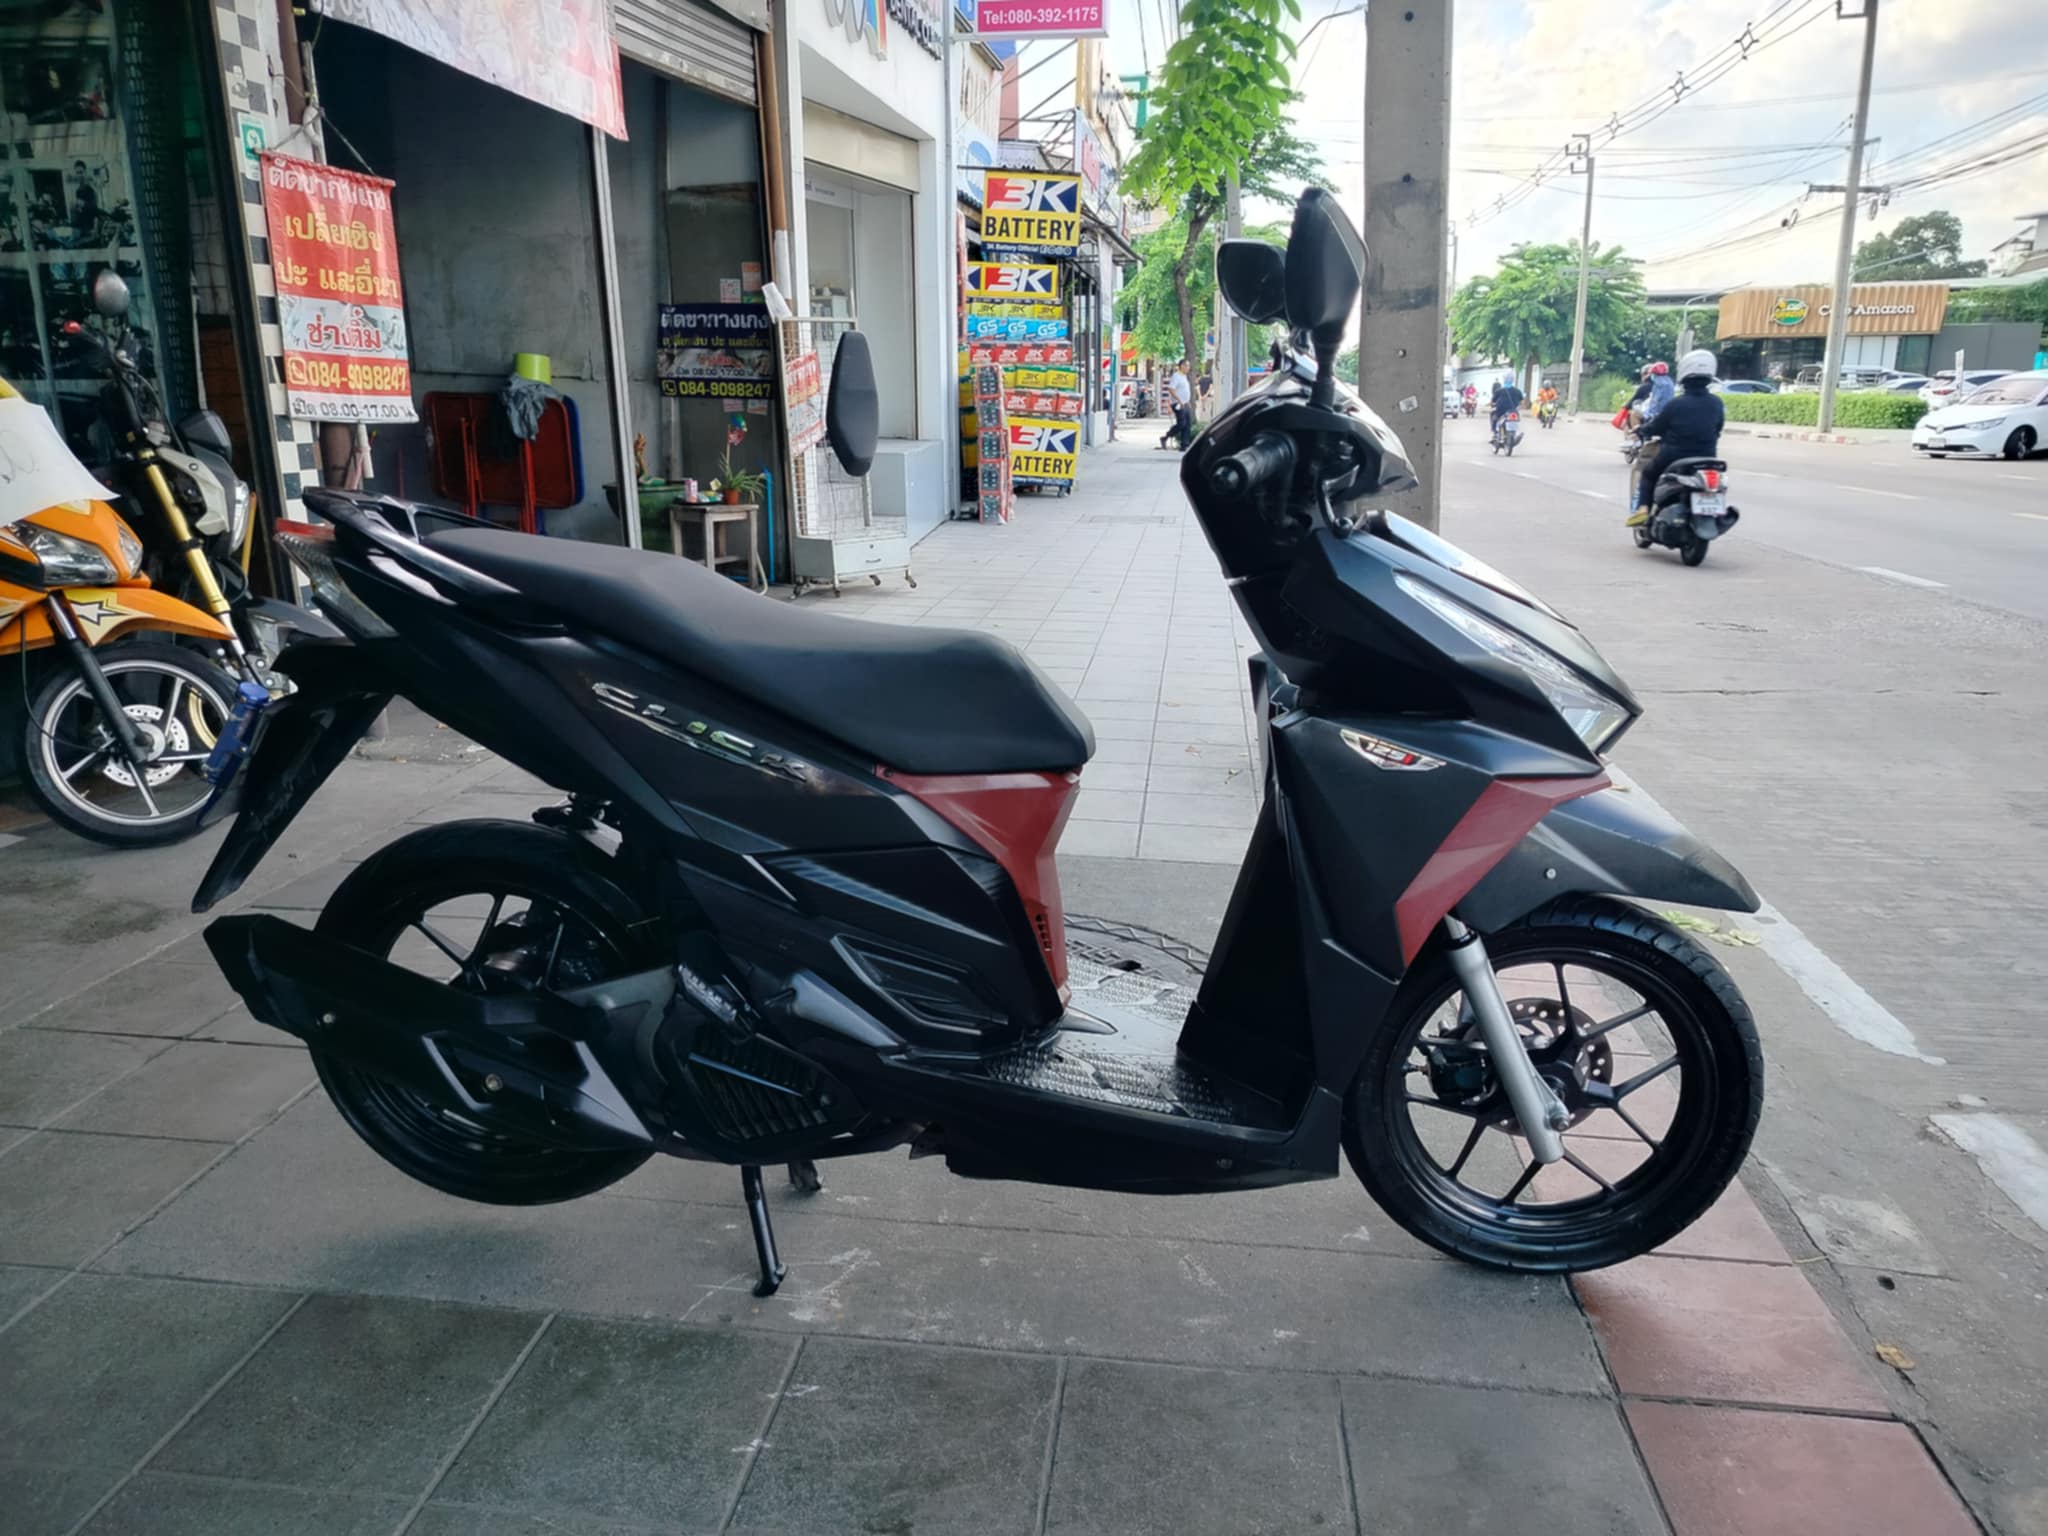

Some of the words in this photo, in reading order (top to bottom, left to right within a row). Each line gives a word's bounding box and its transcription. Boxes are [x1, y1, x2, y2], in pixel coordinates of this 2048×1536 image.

[984, 8, 1099, 25] Tel:080-392-1175
[990, 178, 1078, 213] 3K
[985, 216, 1076, 240] BATTERY
[278, 256, 308, 286] ปะ
[987, 268, 1053, 293] 3K
[1854, 304, 1916, 316] Amazon
[977, 320, 998, 333] GS
[1008, 320, 1027, 333] GS
[1038, 322, 1057, 336] GS
[308, 361, 406, 391] 084-9098247
[679, 381, 771, 397] 084-9098247
[320, 402, 399, 418] 08.00-17.00
[1011, 426, 1077, 454] 3K
[1013, 456, 1073, 474] ATTERY
